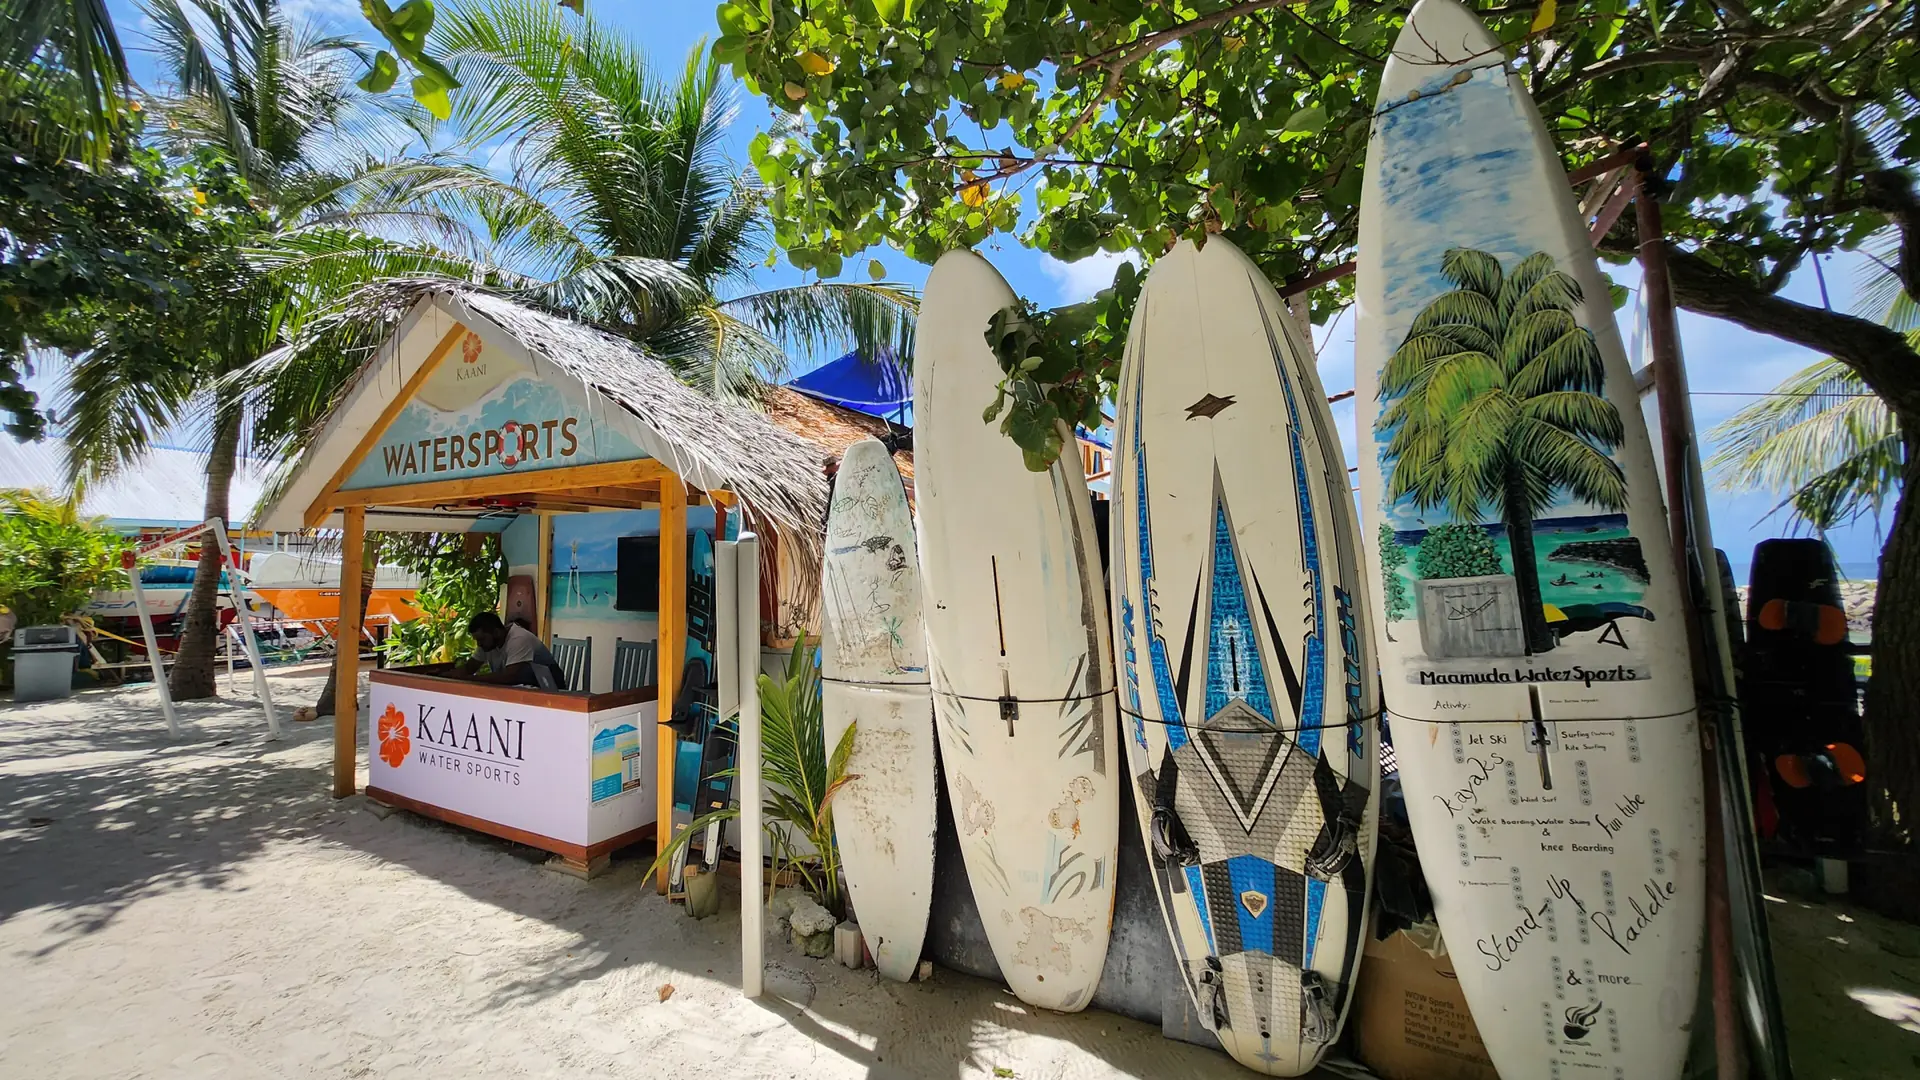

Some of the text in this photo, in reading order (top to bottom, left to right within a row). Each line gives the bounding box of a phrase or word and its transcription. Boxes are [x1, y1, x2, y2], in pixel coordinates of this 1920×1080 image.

[456, 364, 487, 381] KAANI
[383, 417, 578, 477] WATERSPORTS
[687, 567, 712, 655] JOBE
[1122, 594, 1148, 750] NAISH
[1333, 584, 1364, 760] NAISH
[1420, 665, 1636, 688] Maamuda Water Sports
[416, 703, 526, 761] KAANI
[1468, 734, 1507, 745] Jet Ski
[1561, 731, 1590, 739] Surfing
[418, 751, 520, 786] WATER SPORTS
[1468, 816, 1497, 825] Wake
[1541, 828, 1551, 836] &
[1572, 843, 1614, 855] Boarding
[1590, 878, 1676, 955] Paddle
[1566, 969, 1582, 985] &
[1428, 996, 1455, 1010] Sports
